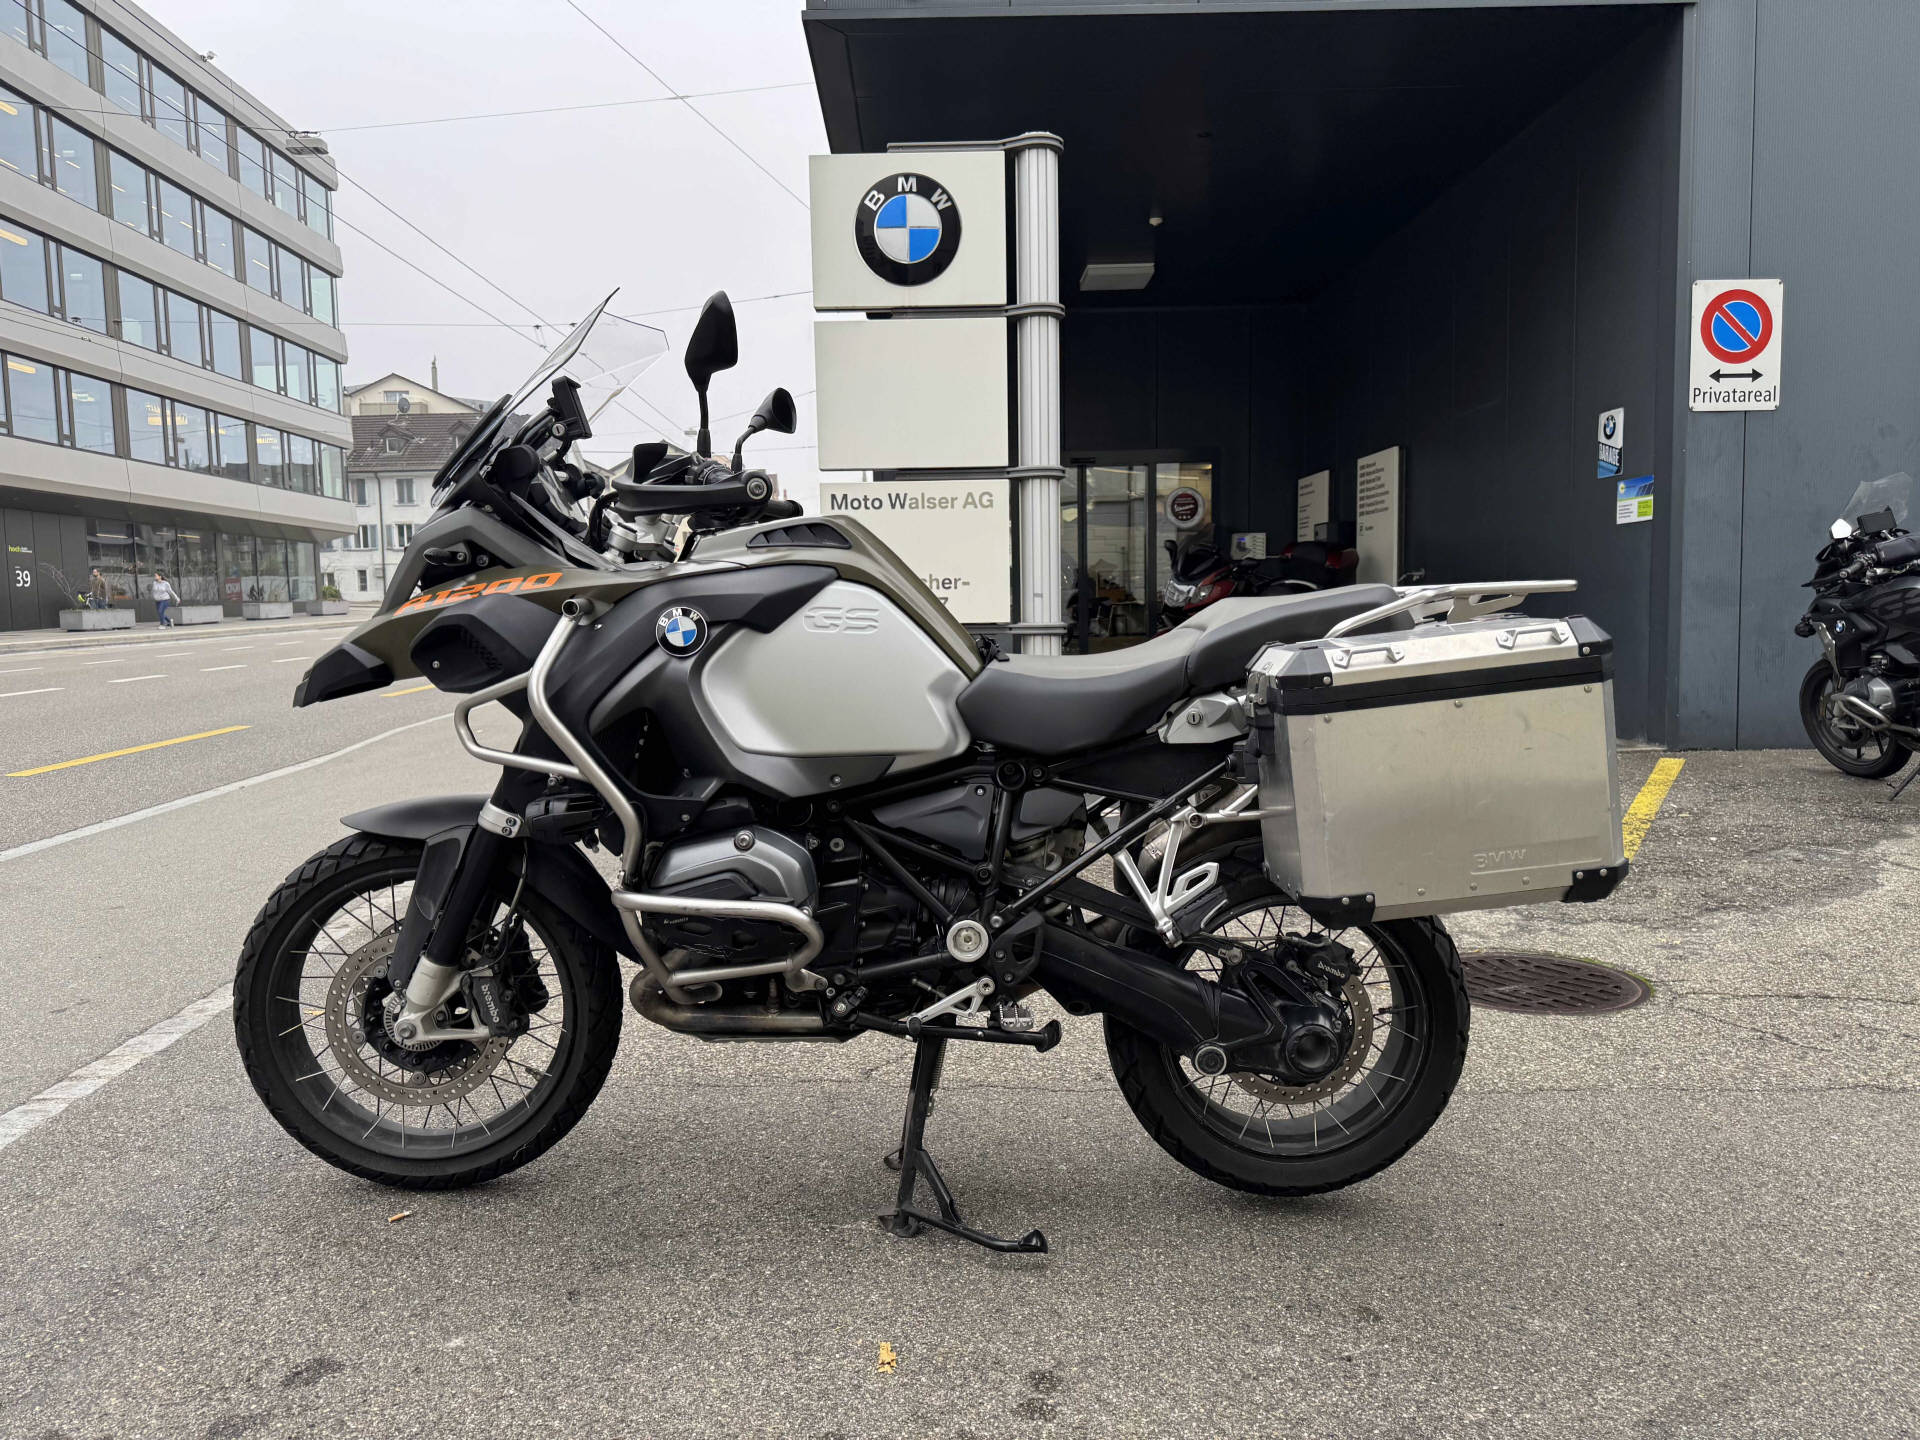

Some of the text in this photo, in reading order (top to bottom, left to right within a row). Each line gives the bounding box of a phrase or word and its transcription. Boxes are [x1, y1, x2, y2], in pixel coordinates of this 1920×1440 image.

[863, 175, 952, 212] BMW
[1693, 384, 1777, 404] Privatareal
[830, 491, 994, 510] Moto Walser AG
[15, 570, 31, 587] 39
[393, 572, 563, 617] R1200
[658, 608, 700, 627] BMW
[803, 606, 880, 634] GS
[1473, 848, 1528, 868] BMW
[481, 983, 500, 1023] brembo
